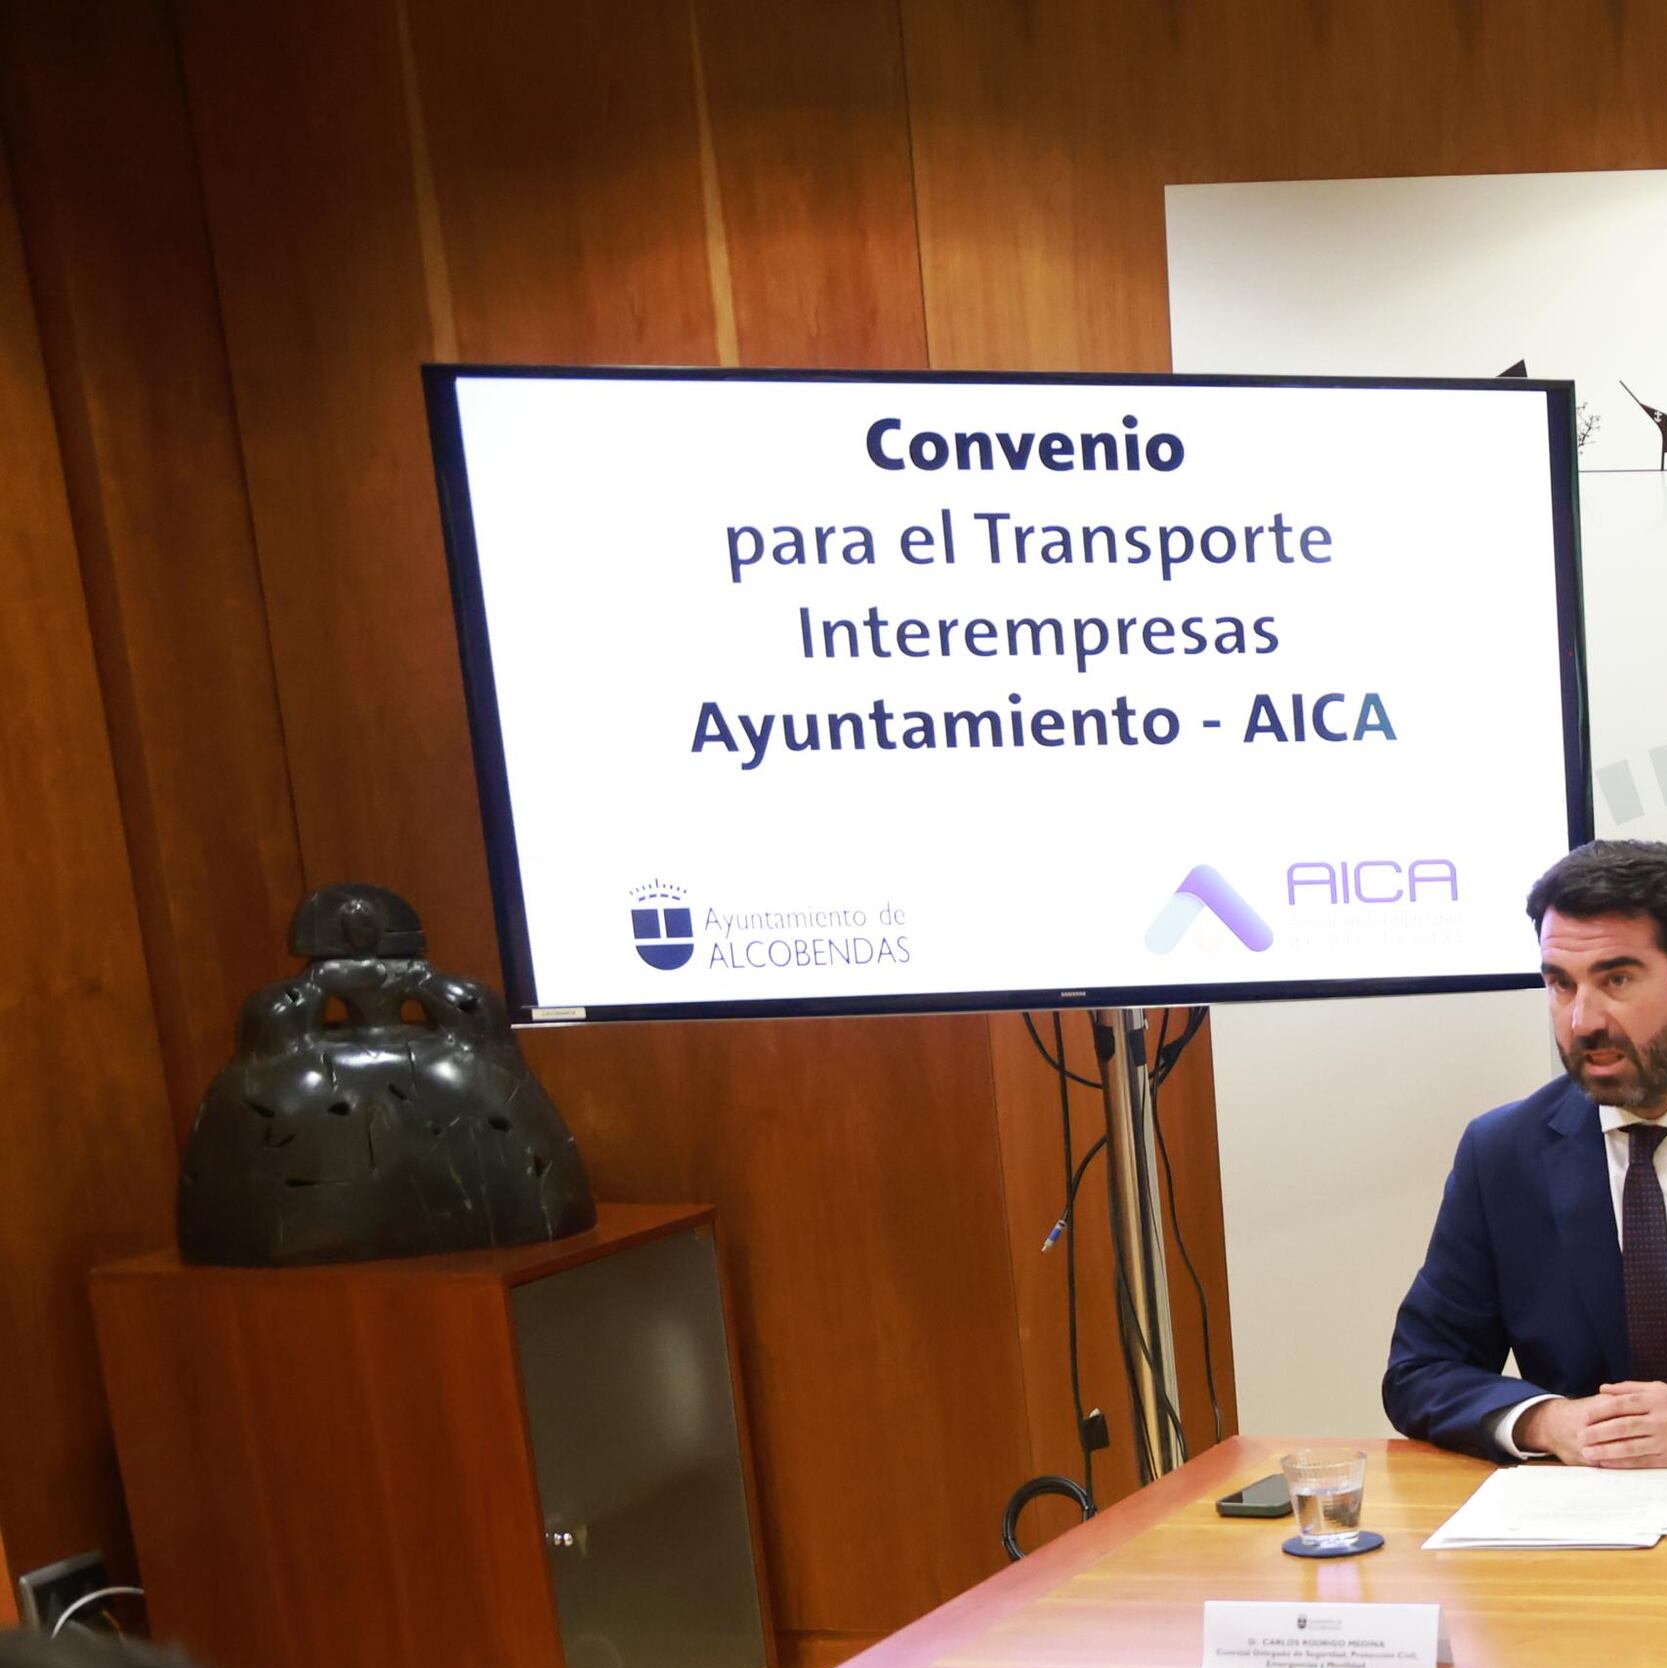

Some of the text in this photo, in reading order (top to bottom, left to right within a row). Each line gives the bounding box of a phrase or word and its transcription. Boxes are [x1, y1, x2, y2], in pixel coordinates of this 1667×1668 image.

[866, 414, 1185, 473] Convenio
[725, 509, 1333, 583] para el Transporte
[799, 606, 1280, 673] Interempresas
[690, 692, 1397, 770] Ayuntamiento - AICA
[1286, 858, 1459, 906] AICA
[704, 901, 906, 940] Ayuntamiento de
[709, 934, 911, 969] ALCOBENDAS
[1262, 1638, 1299, 1647] CARLOS
[1302, 1638, 1346, 1648] RODRIGO
